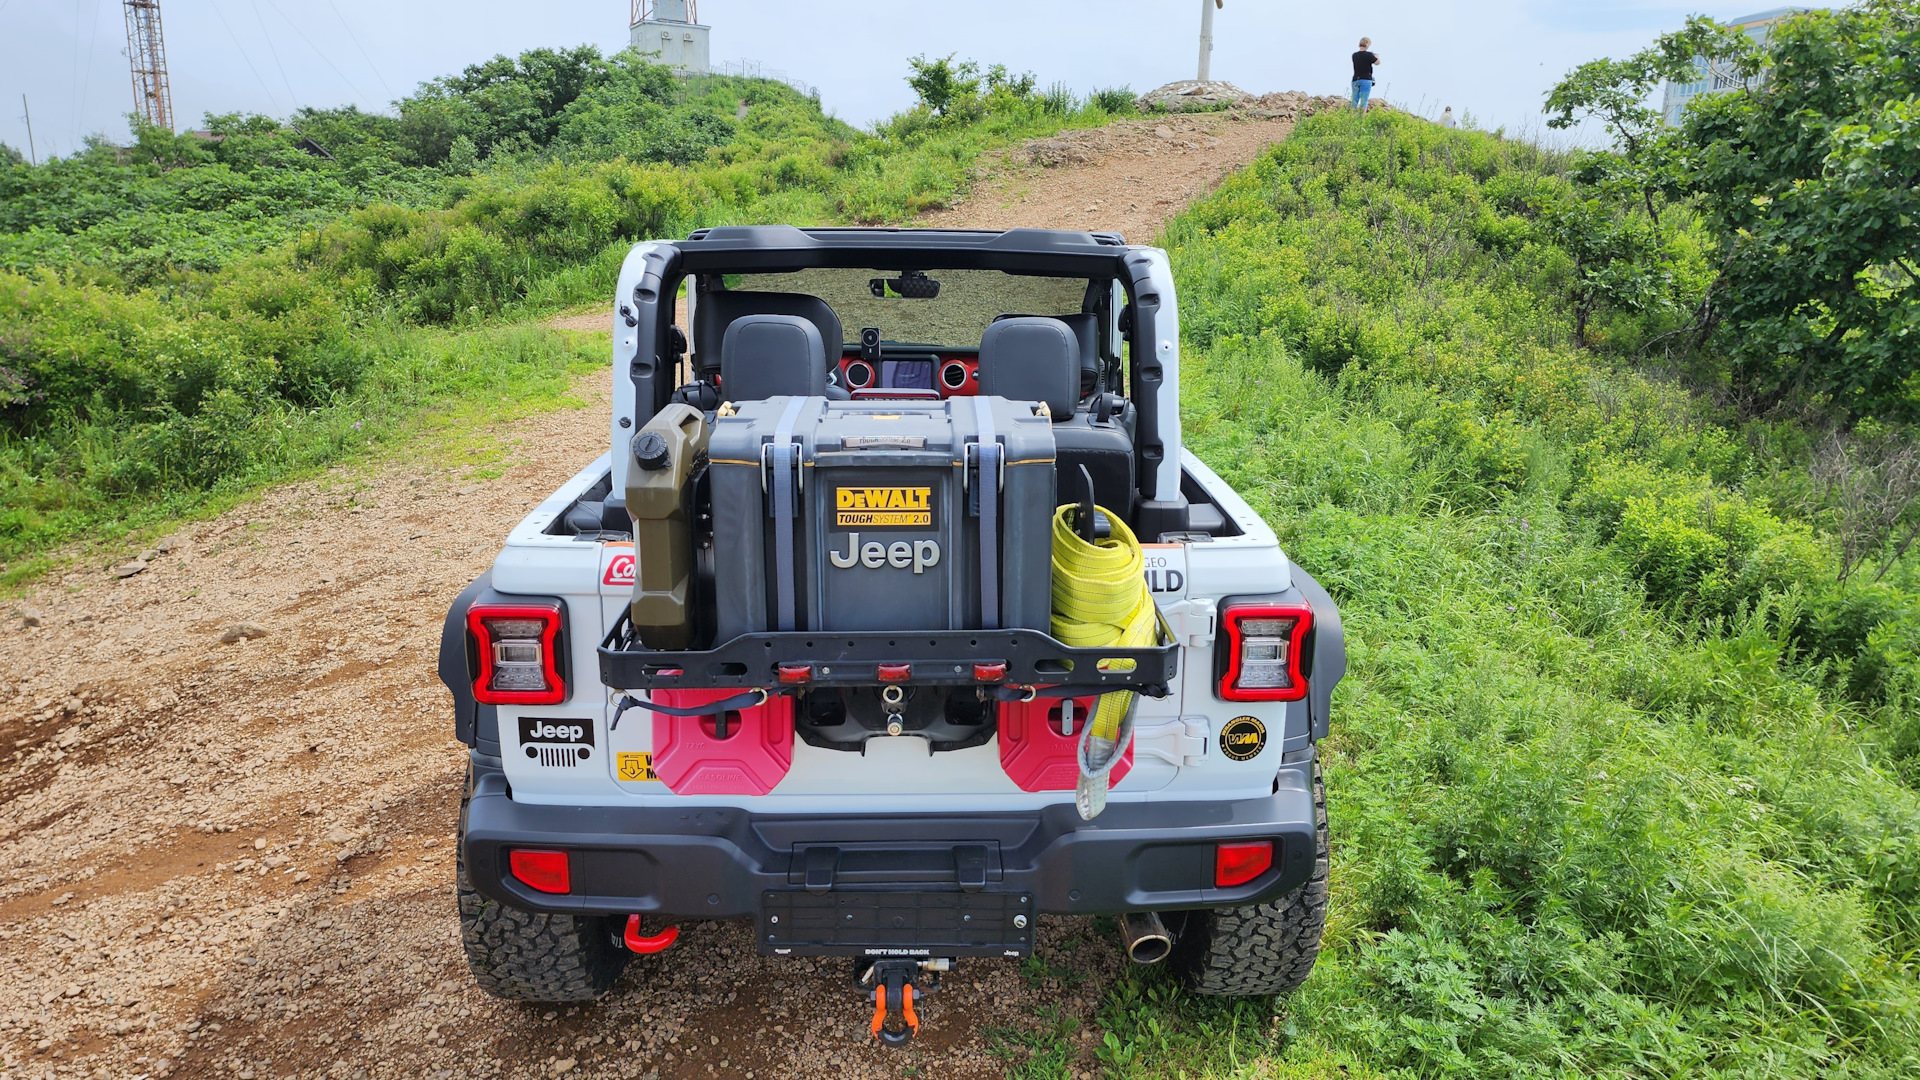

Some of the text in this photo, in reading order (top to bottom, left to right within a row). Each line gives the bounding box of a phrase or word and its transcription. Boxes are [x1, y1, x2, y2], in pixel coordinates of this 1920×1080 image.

[839, 514, 929, 524] TOUGHSYSTEM 2.0
[830, 532, 940, 574] Jeep
[530, 721, 584, 742] Jeep
